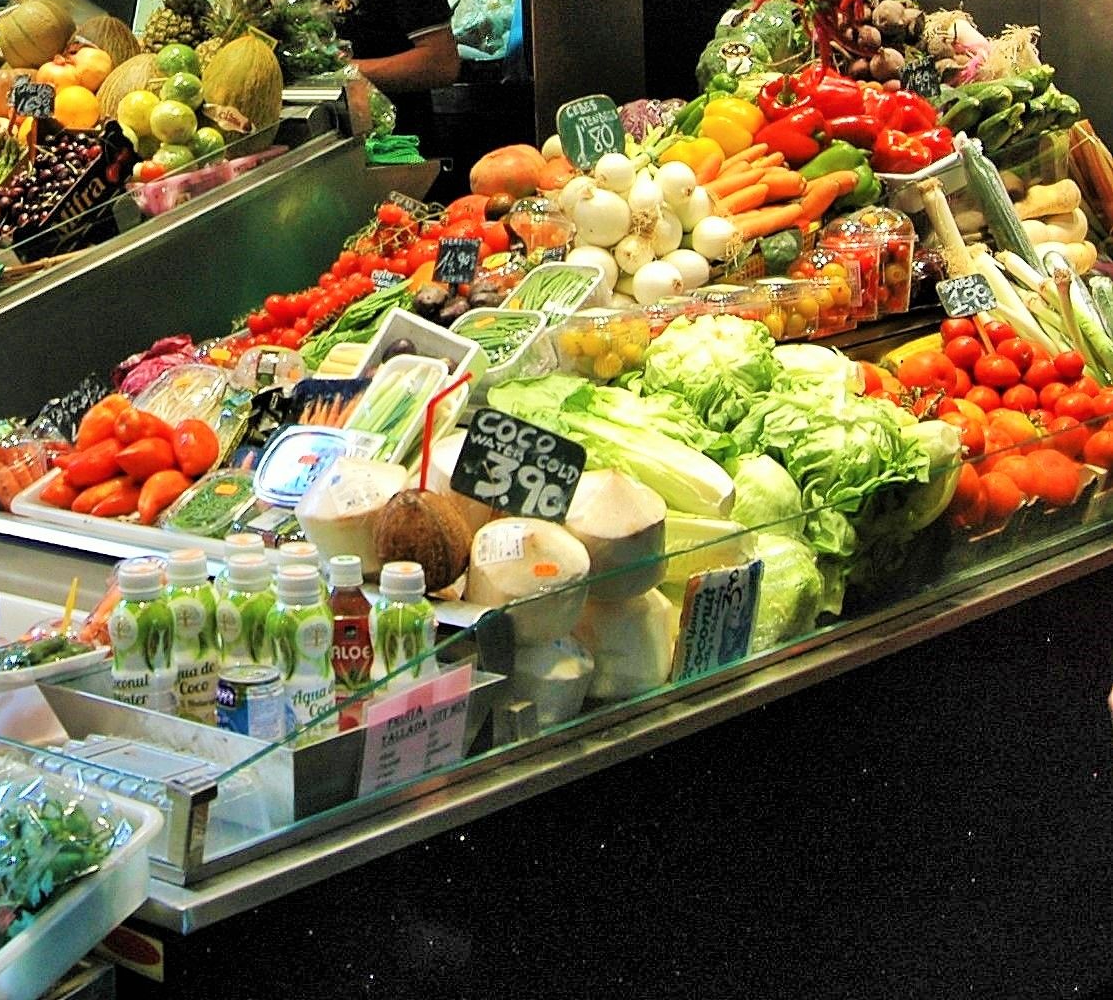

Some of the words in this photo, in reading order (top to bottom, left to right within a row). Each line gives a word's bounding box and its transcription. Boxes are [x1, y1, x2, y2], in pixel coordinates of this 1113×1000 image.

[477, 411, 557, 454] COCO
[470, 432, 525, 463] WATER
[536, 454, 580, 486] COLD
[331, 645, 373, 660] ALOE
[179, 680, 209, 696] Coco
[292, 687, 326, 707] Agua
